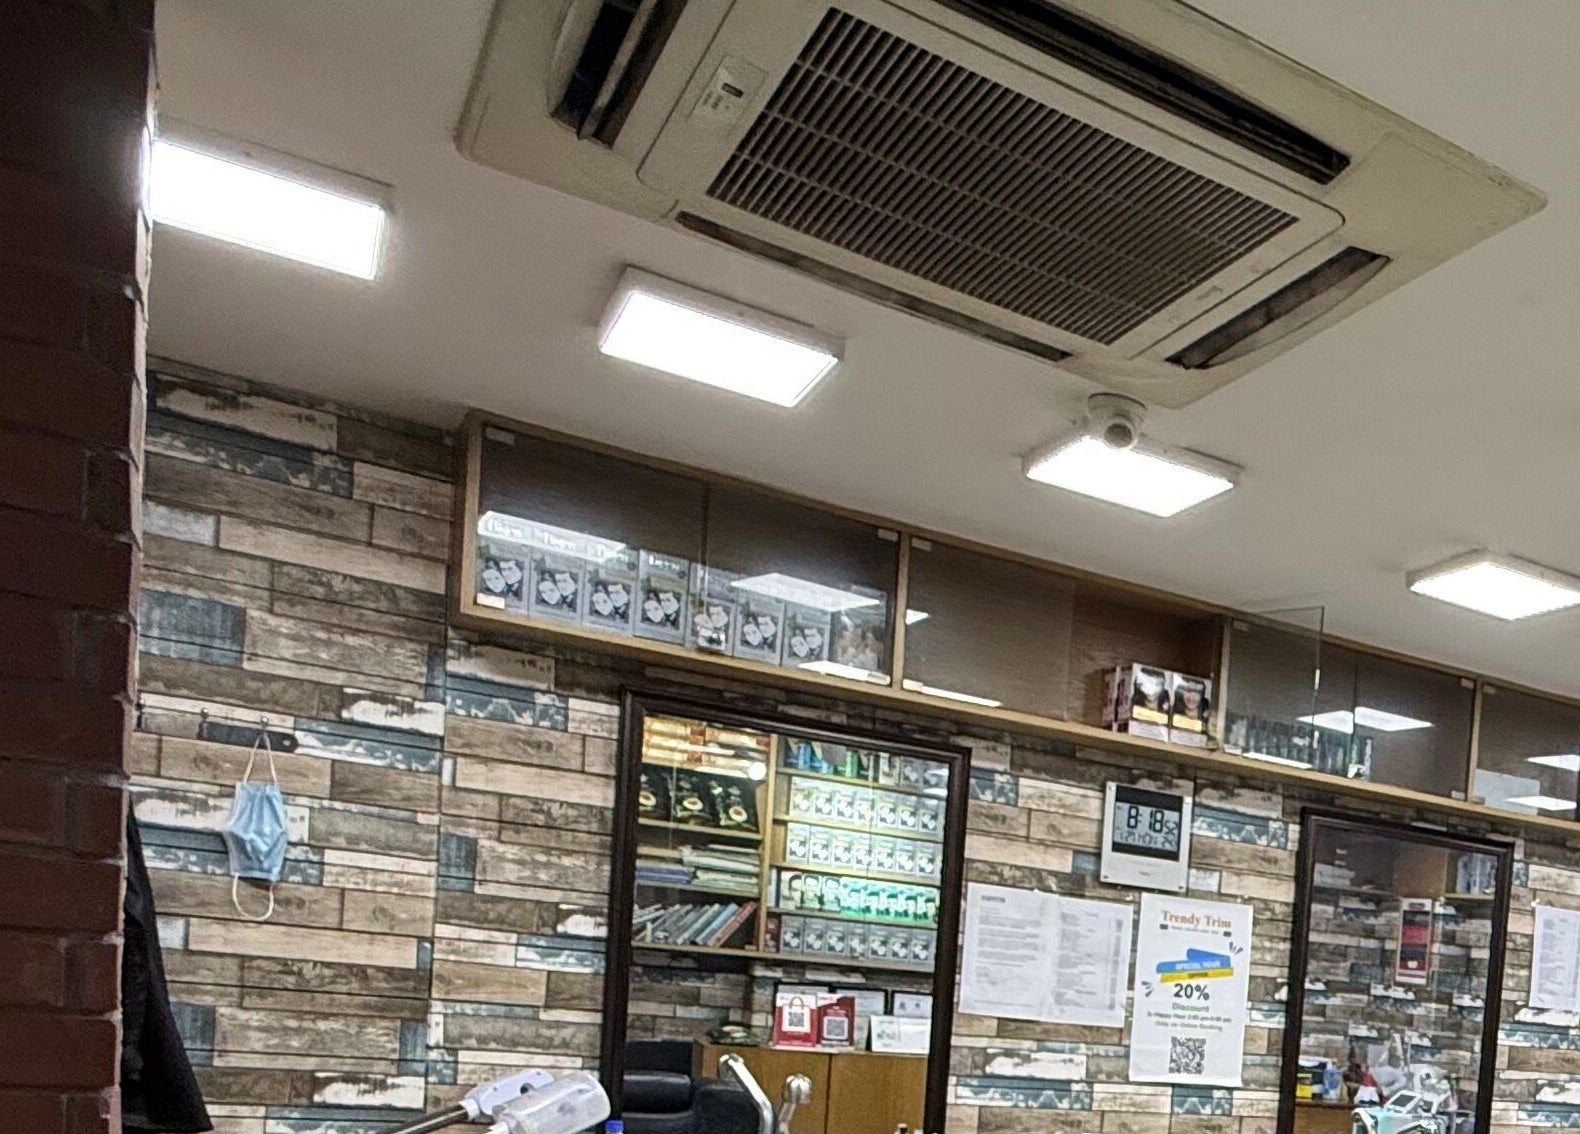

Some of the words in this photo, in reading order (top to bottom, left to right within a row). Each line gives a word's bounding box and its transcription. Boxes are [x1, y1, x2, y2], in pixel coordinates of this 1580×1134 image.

[1127, 804, 1165, 833] 8:18
[1162, 910, 1201, 929] Trendy
[1204, 915, 1232, 928] Trim
[1174, 983, 1210, 1001] 20%
[1172, 1002, 1210, 1013] Discount
